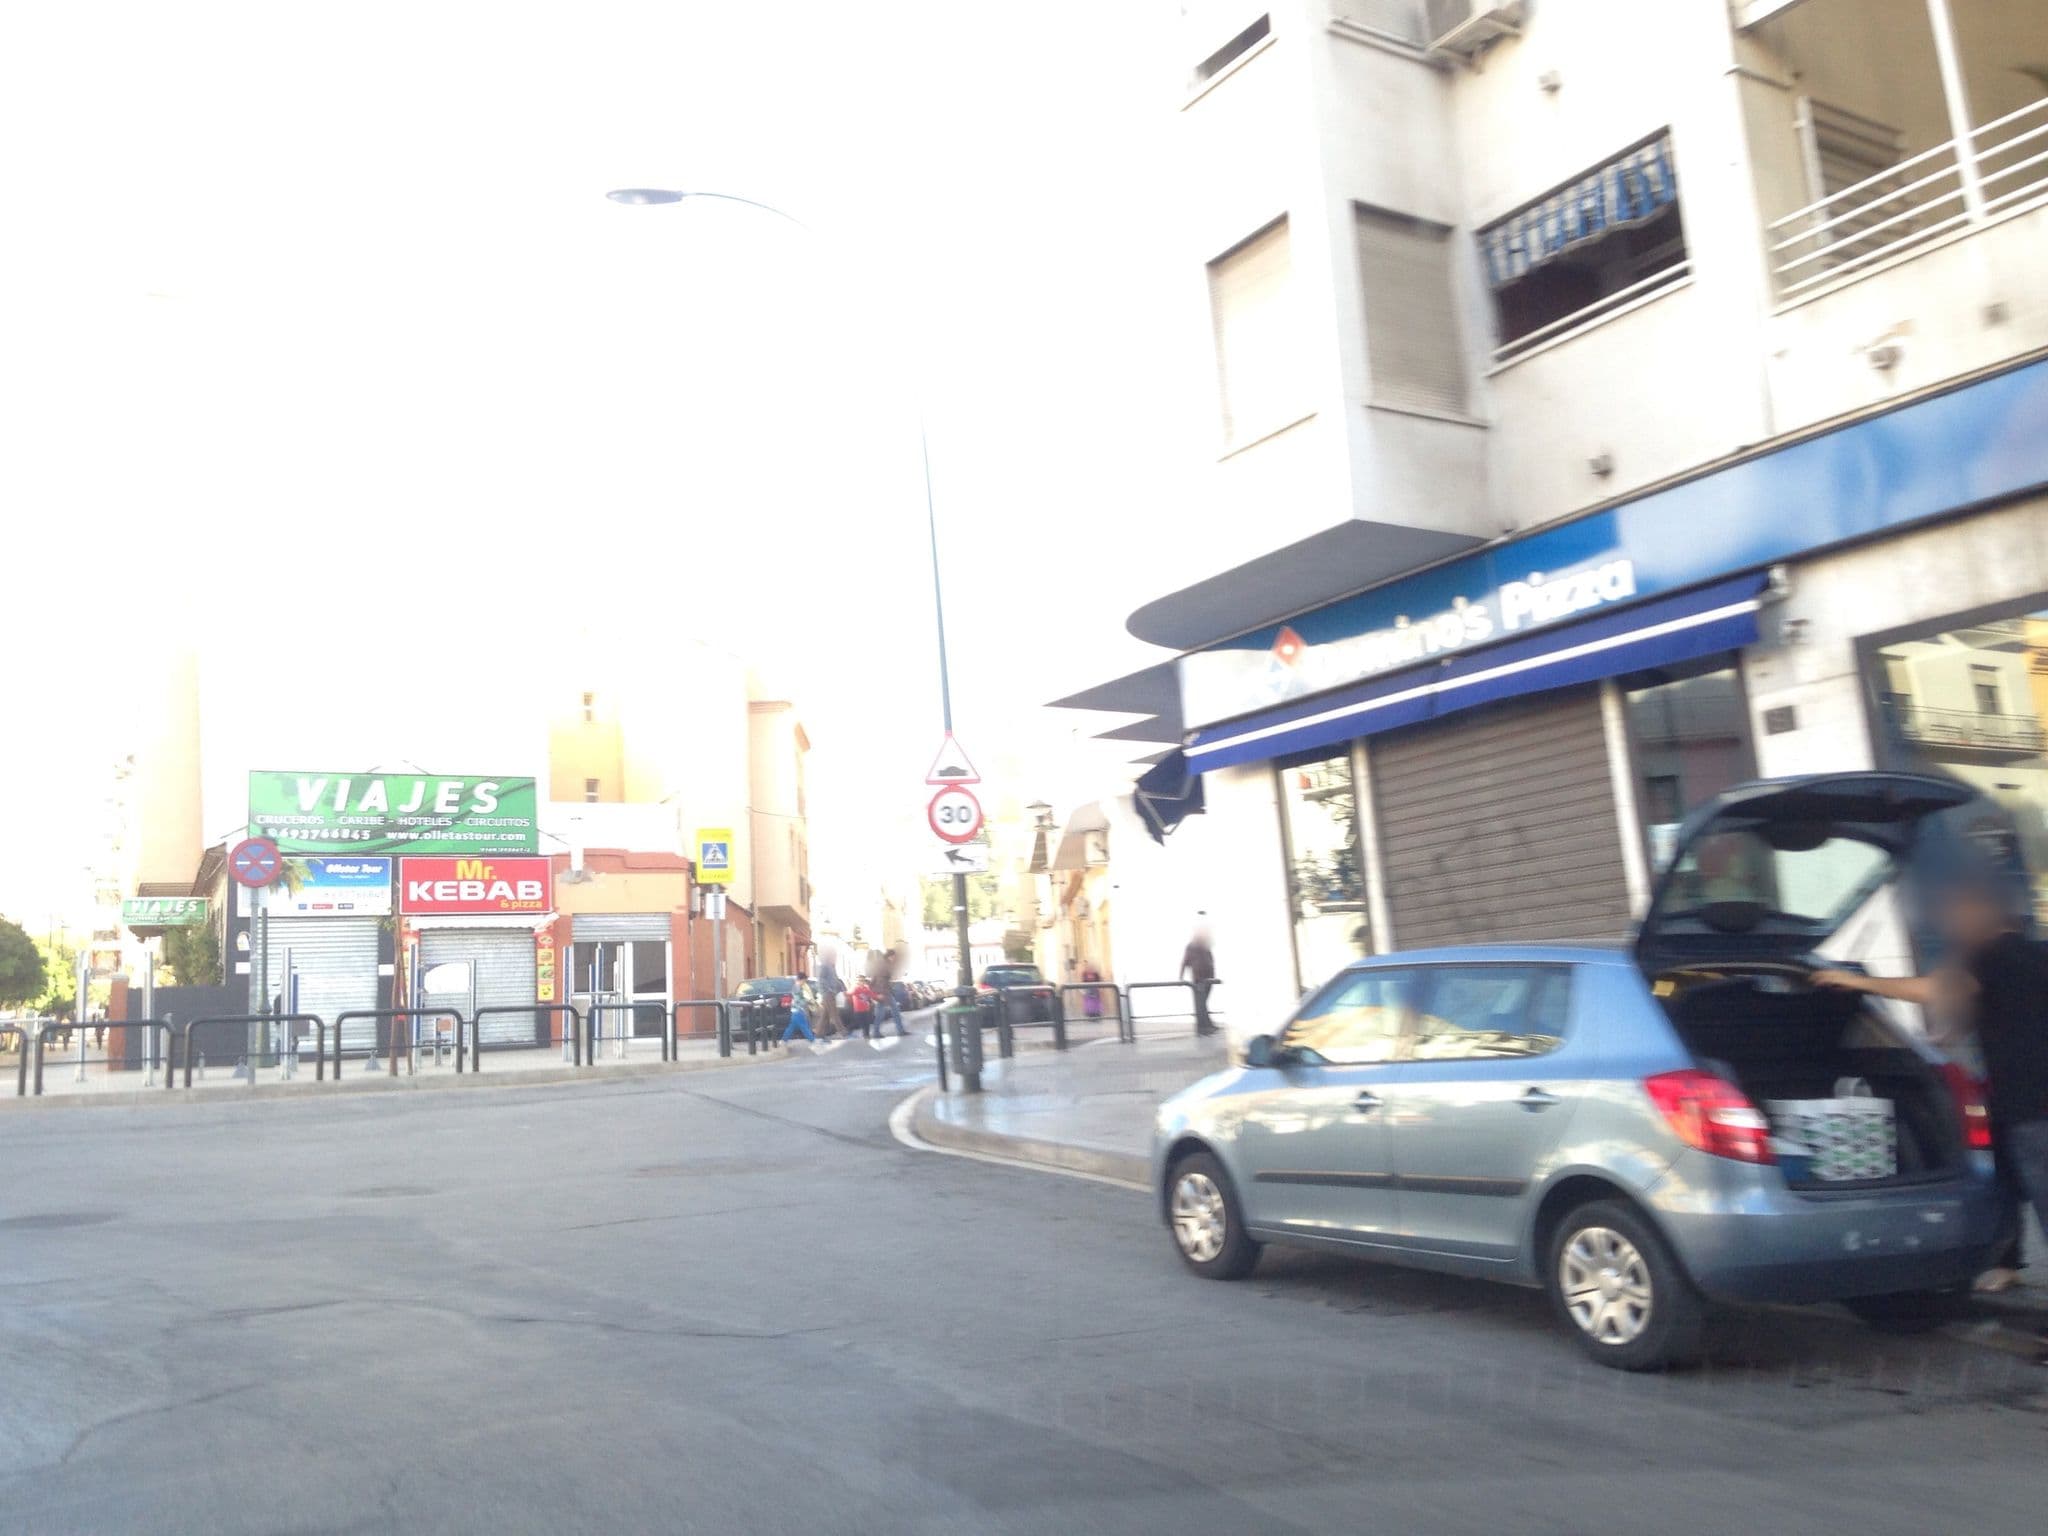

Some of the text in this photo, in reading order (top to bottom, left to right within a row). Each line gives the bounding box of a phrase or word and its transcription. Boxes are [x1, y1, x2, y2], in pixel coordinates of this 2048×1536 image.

[1302, 560, 1636, 688] Dino's Pizza
[297, 779, 499, 813] VIAJES
[256, 815, 324, 825] CRUCEROS
[340, 816, 385, 825] CARIBE
[398, 816, 452, 826] HOTELES
[465, 817, 530, 827] CIRCUITOS
[940, 806, 972, 823] 30
[456, 860, 497, 880] Mr.
[408, 880, 543, 902] KEBAB
[130, 900, 198, 912] VIAJES
[511, 901, 543, 910] pizza
